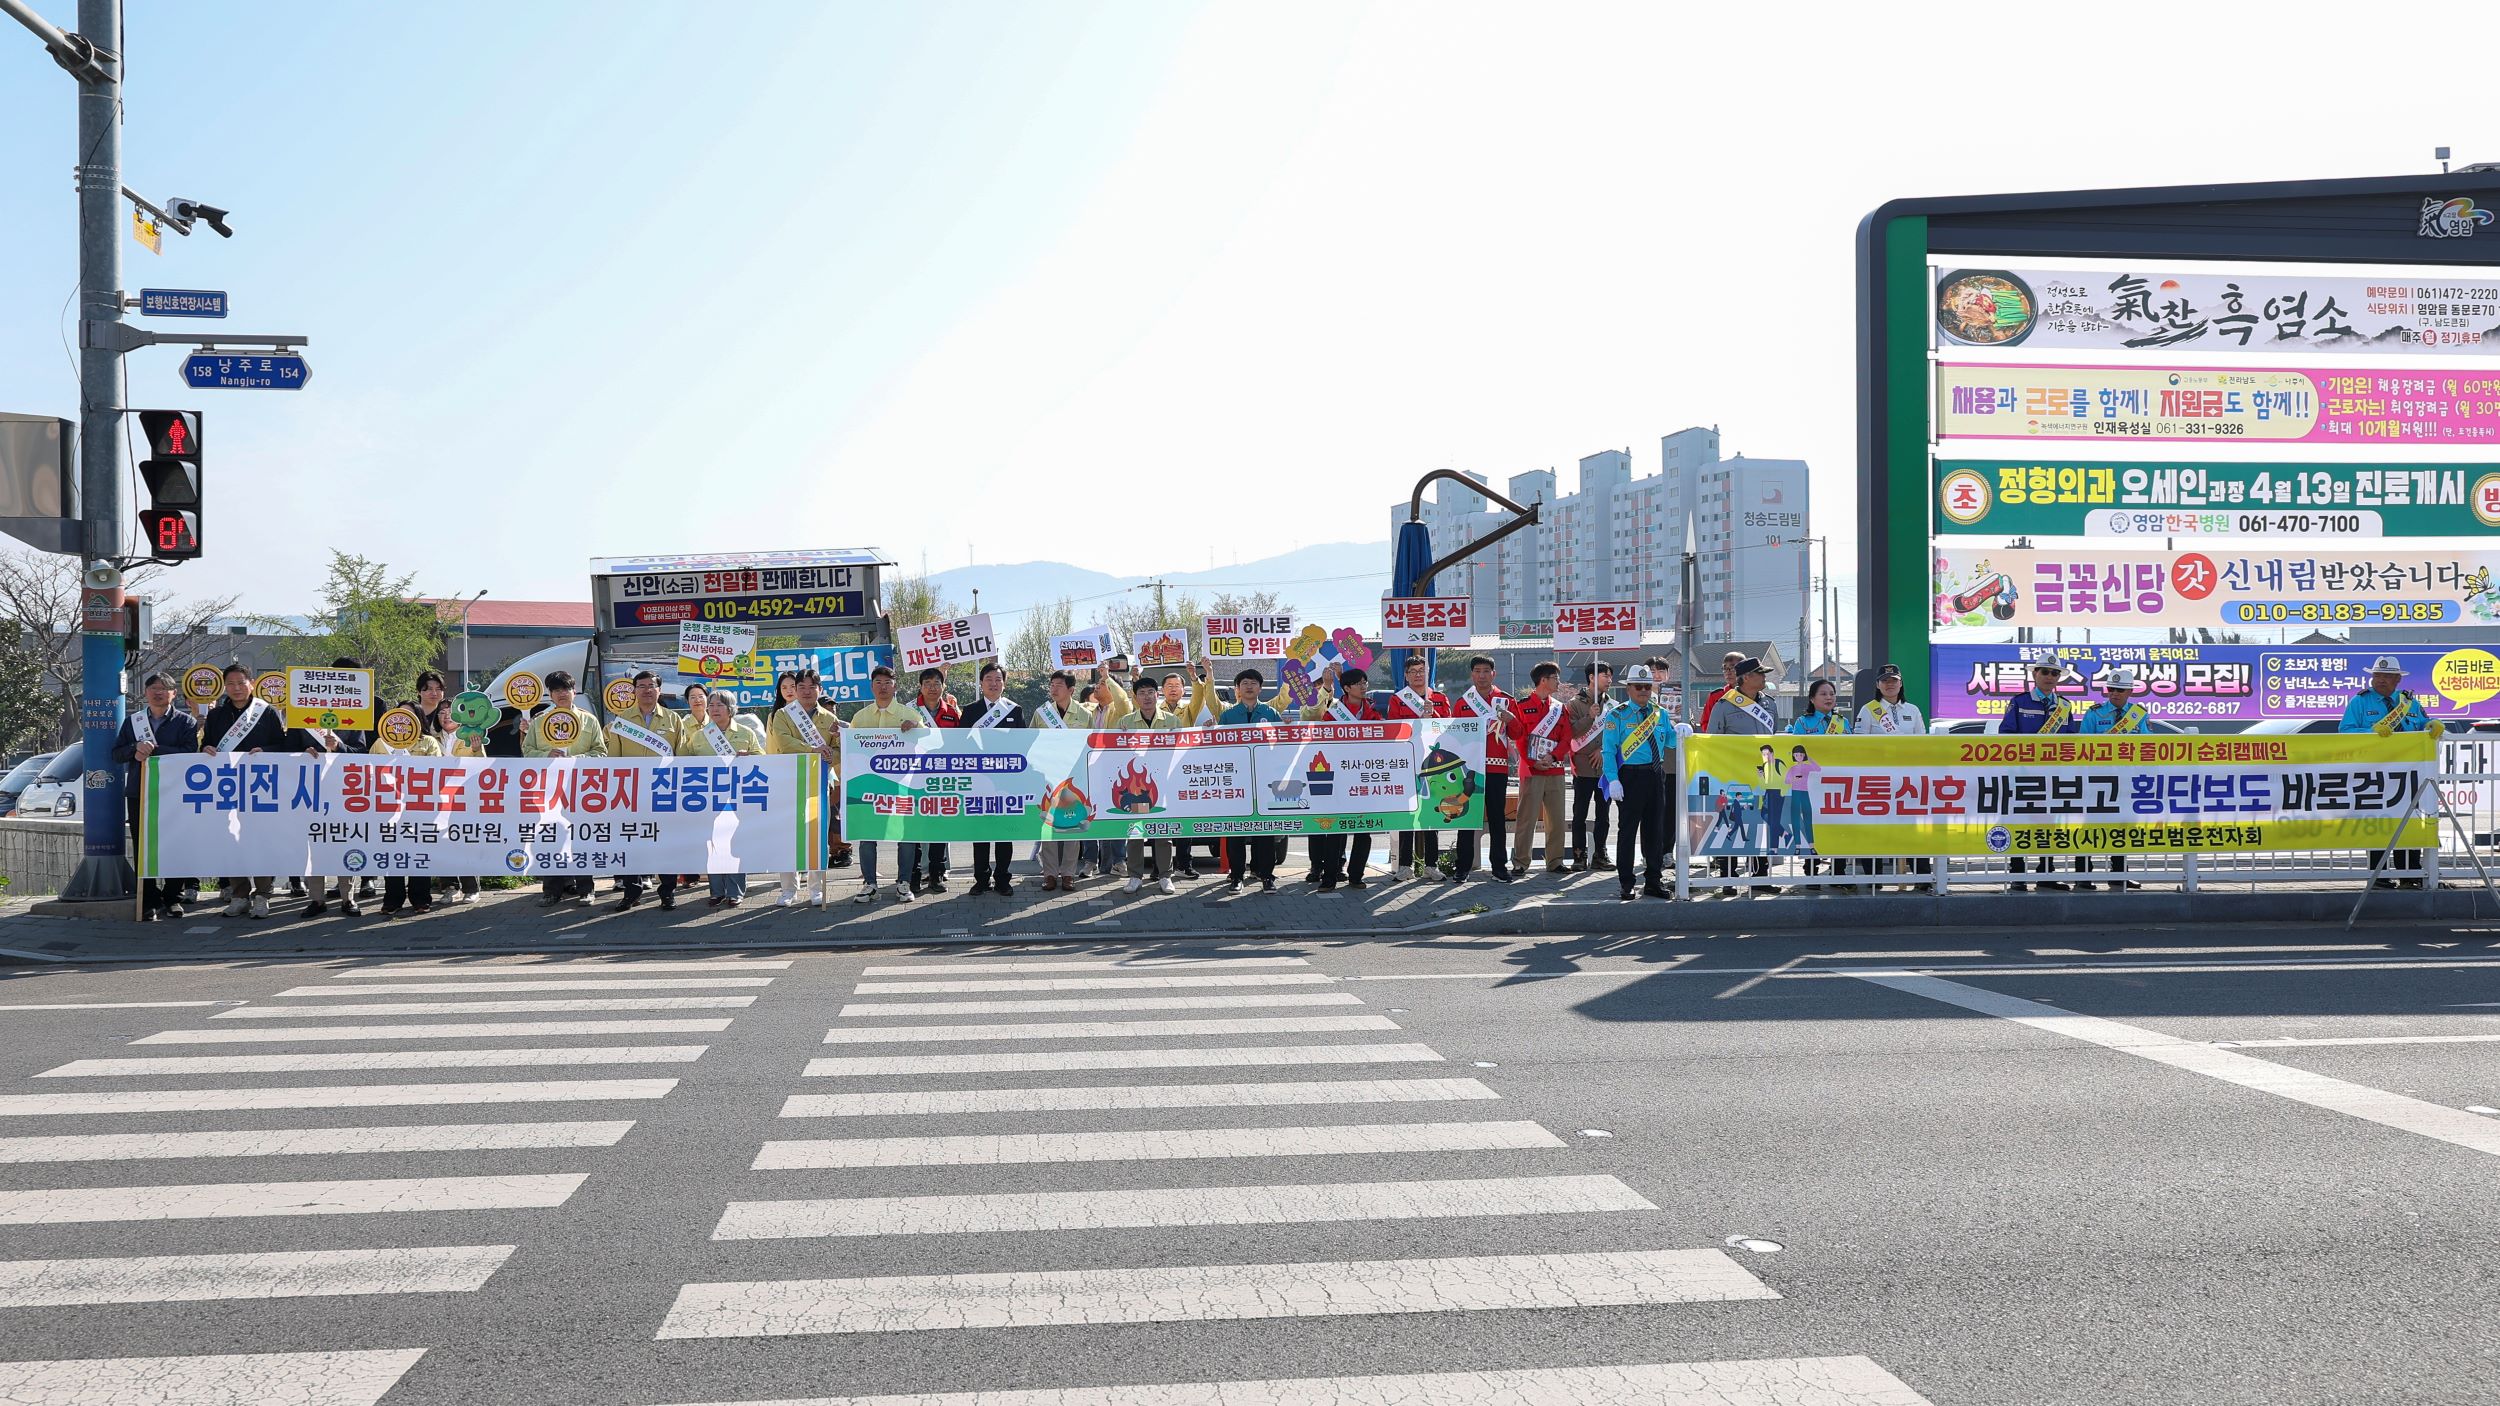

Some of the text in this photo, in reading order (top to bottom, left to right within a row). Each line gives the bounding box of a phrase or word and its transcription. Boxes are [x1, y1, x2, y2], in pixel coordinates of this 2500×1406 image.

[2450, 219, 2473, 236] 영암
[2046, 287, 2089, 298] 정성으로
[2366, 286, 2498, 300] 예약문의 061)472-2220
[146, 295, 221, 312] 보행신호연장시스템
[2047, 303, 2094, 315] 한 그릇에
[2367, 303, 2495, 316] 식당위치 영암읍 동문로70
[2213, 283, 2353, 346] 흑염소
[2047, 319, 2077, 333] 기운을
[2401, 331, 2421, 343] 매주
[2441, 332, 2481, 344] 정기휴무
[192, 358, 299, 379] 158 낭주로 154
[220, 376, 271, 388] Nangju-ro
[2228, 376, 2256, 384] 전라남도
[2328, 376, 2457, 397] 기업은! 채용장려금 (월
[1952, 386, 2309, 420] 채용과 근로를 함께! 지원금도 함께!!
[2328, 399, 2385, 416] 근로자는!
[2390, 400, 2449, 417] 취업장려금
[2094, 421, 2151, 434] 인재육성실
[2157, 423, 2244, 434] 061-331-9326
[2328, 421, 2351, 435] 최대
[1999, 467, 2115, 504] 정형외과
[2250, 472, 2292, 504] 4월
[2297, 472, 2350, 504] 13일
[2356, 470, 2465, 505] 진료개시
[1953, 484, 1977, 509] 초
[1744, 511, 1801, 527] 청송드림빌
[2132, 514, 2360, 532] 영암한국병원 061-470-7100
[1766, 535, 1781, 545] 101
[623, 566, 852, 597] 신안(소금) 천일염 판매합니다
[2034, 563, 2165, 613] 금꽃신당
[2177, 560, 2209, 592] 갓
[704, 596, 844, 619] 010-4592-4791
[2238, 603, 2443, 621] 010-8183-9185
[1384, 603, 1467, 628] 산불조심
[1556, 606, 1636, 632] 산불조심
[683, 622, 700, 632] 운행
[732, 626, 755, 636] 중에는
[921, 620, 970, 644] 산불은
[1206, 617, 1291, 635] 불씨 하나로
[682, 633, 724, 644] 스마트폰을
[1421, 632, 1445, 641] 영암군
[1591, 636, 1615, 645] 영암군
[682, 643, 698, 653] 잠시
[907, 636, 992, 666] 재난입니다
[1060, 640, 1093, 650] 산에서는
[1138, 636, 1185, 667] 산불
[1209, 637, 1244, 656] 마을
[1248, 637, 1287, 655] 위험!
[2057, 647, 2199, 662] 배우고, 건강하게 움직여요!
[2284, 658, 2347, 671] 초보자 환영!
[2446, 660, 2493, 673] 지금 바로
[304, 671, 356, 682] 횡단보도를
[2184, 662, 2250, 694] 모집!
[2284, 676, 2365, 690] 남녀노소 누구나
[2439, 676, 2500, 691] 신청하세요!
[299, 683, 362, 695] 건너기 전에는
[297, 697, 363, 708] 좌우를 살펴요
[2284, 695, 2347, 708] 즐거운분위기
[554, 722, 569, 735] 30
[1461, 721, 1479, 732] 영암
[1116, 726, 1385, 746] 실수로 산불 시 3년 이하 징역 또는 3천만원 이하 벌금
[1960, 741, 2288, 762] 2026년 교통사고 확 줄이기 순회캠페인
[875, 757, 1022, 771] 2026년 4월 안전 한바퀴
[1182, 763, 1238, 774] 영농부산물,
[925, 776, 972, 791] 영암군
[1189, 776, 1233, 787] 쓰레기 등
[1360, 772, 1391, 783] 등으로
[182, 763, 769, 815] 우회전 시, 횡단보도 앞 일시정지 집중단속
[1178, 789, 1245, 800] 불법 소각 금지
[1348, 785, 1404, 797] 산불 시 처벌
[1820, 770, 2421, 816] 교통신호 바로보고 횡단보도 바로걷기
[920, 796, 960, 815] 예방
[1145, 822, 1182, 835] 영암군
[1193, 820, 1303, 833] 영암군재난안전대책본부
[1339, 819, 1383, 830] 영암소방서
[308, 820, 660, 844] 위반시 범칙금 6만원, 벌점 10점 부과
[2014, 825, 2263, 850] 경찰청(사)영암모범운전자회
[373, 852, 431, 869] 영암군
[535, 851, 626, 869] 영암경찰서
